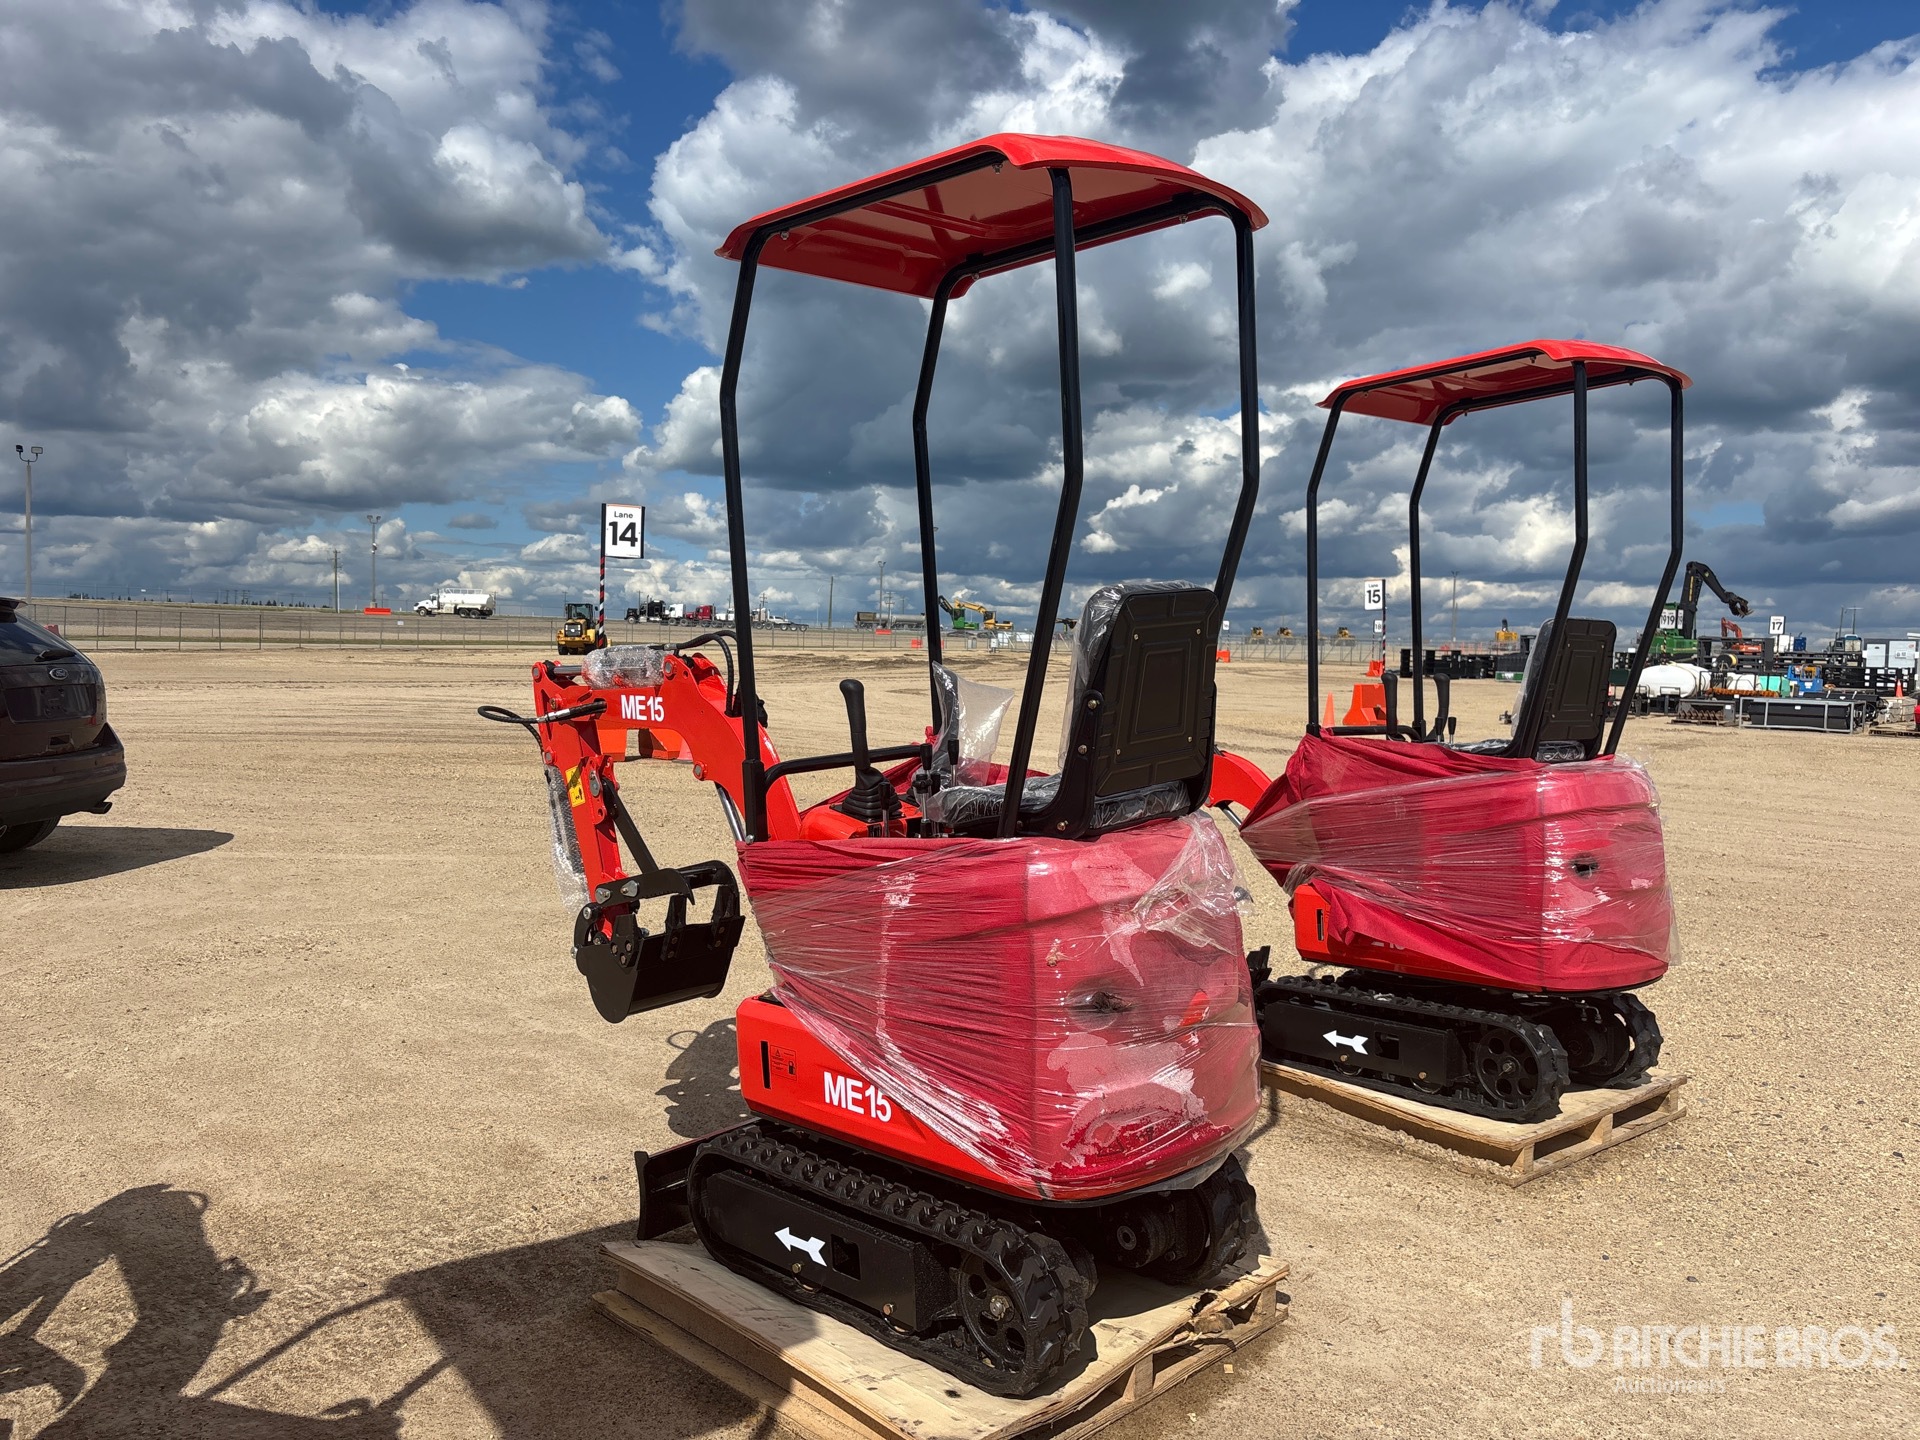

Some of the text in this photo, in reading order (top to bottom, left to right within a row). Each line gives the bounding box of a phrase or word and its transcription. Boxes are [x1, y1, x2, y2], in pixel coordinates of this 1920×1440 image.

[614, 511, 634, 519] Lane
[608, 521, 638, 547] 14
[1366, 589, 1381, 604] 15
[1667, 615, 1675, 625] 19
[1772, 621, 1783, 631] 17
[620, 694, 665, 722] ME15
[823, 1071, 892, 1123] ME15
